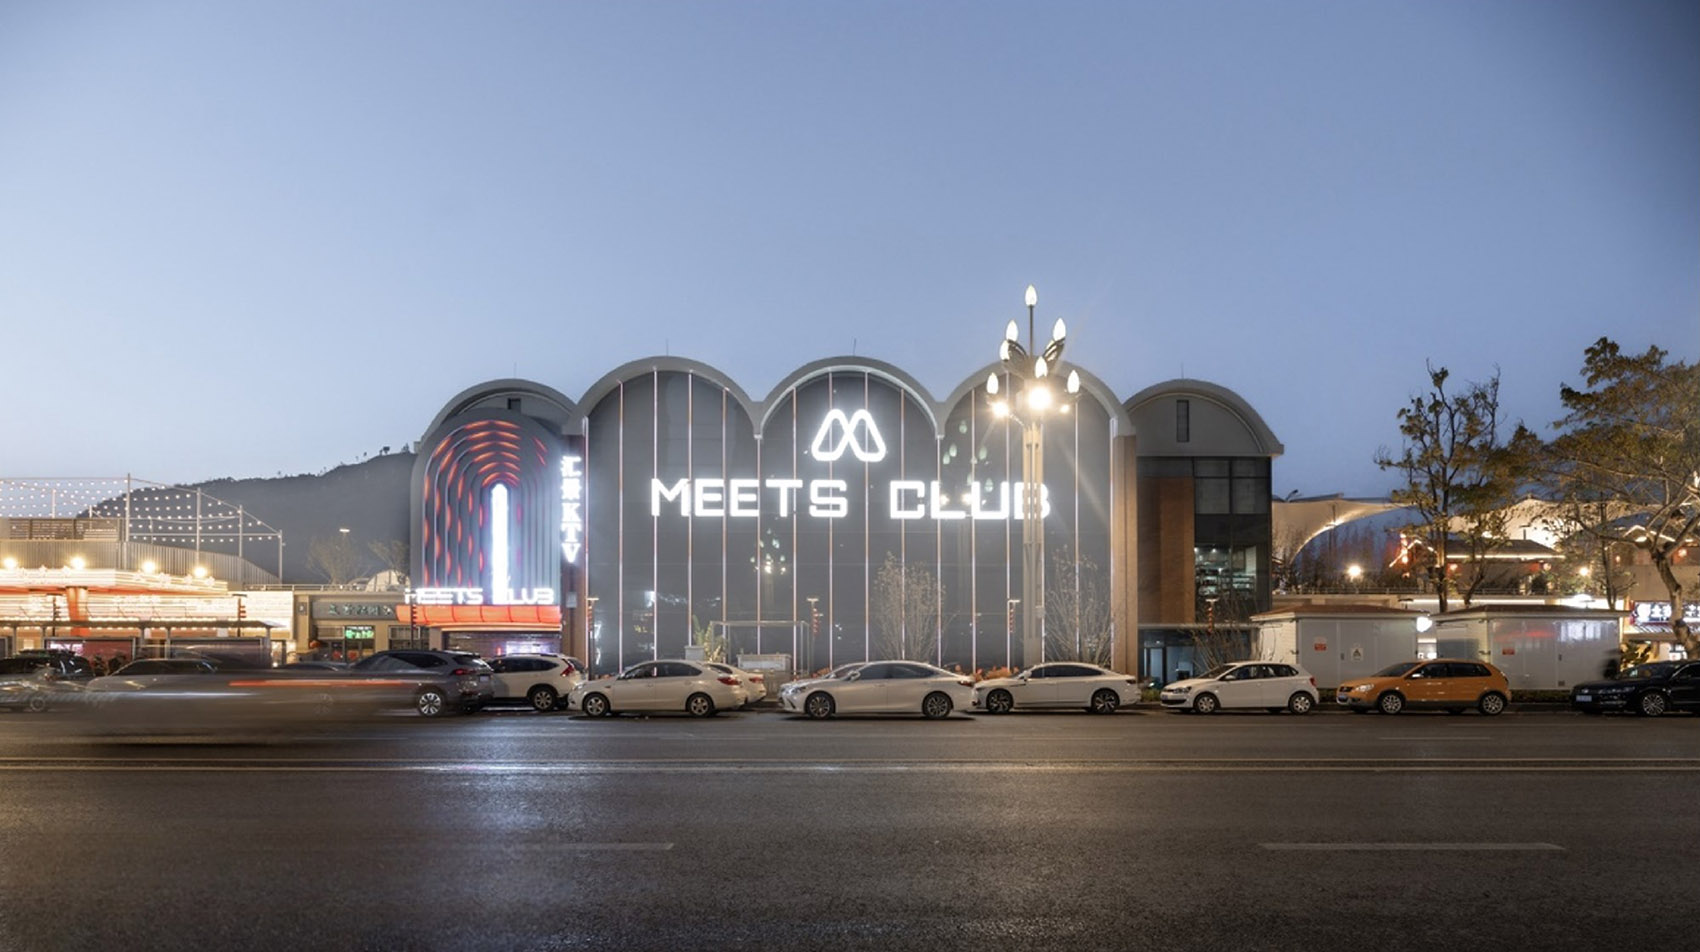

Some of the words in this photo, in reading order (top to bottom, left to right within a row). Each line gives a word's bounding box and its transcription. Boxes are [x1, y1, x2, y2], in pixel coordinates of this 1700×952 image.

[651, 478, 848, 518] MEETS
[890, 480, 1051, 520] CLUB
[404, 587, 484, 605] MEETS
